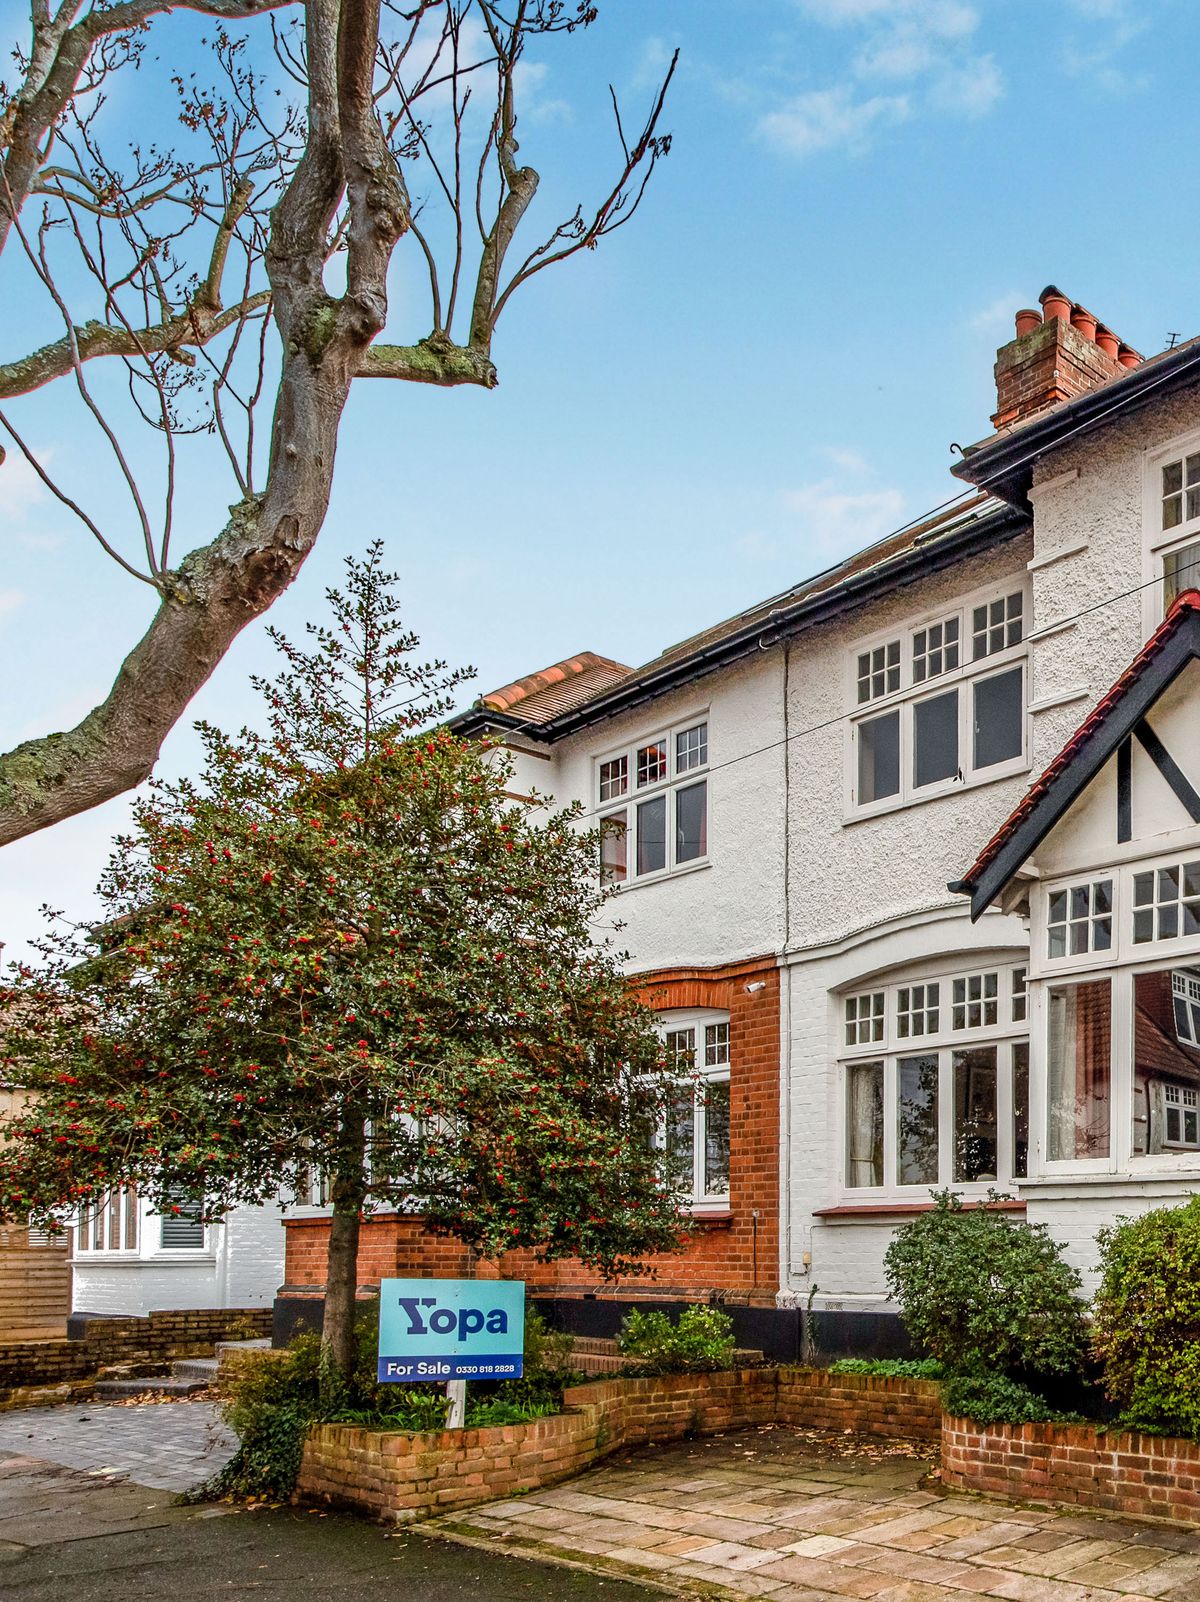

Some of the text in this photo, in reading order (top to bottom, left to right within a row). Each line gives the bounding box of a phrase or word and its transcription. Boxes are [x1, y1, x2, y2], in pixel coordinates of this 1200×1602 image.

[398, 1297, 508, 1342] Yopa
[387, 1361, 515, 1376] For Sale 0330 818 2828
